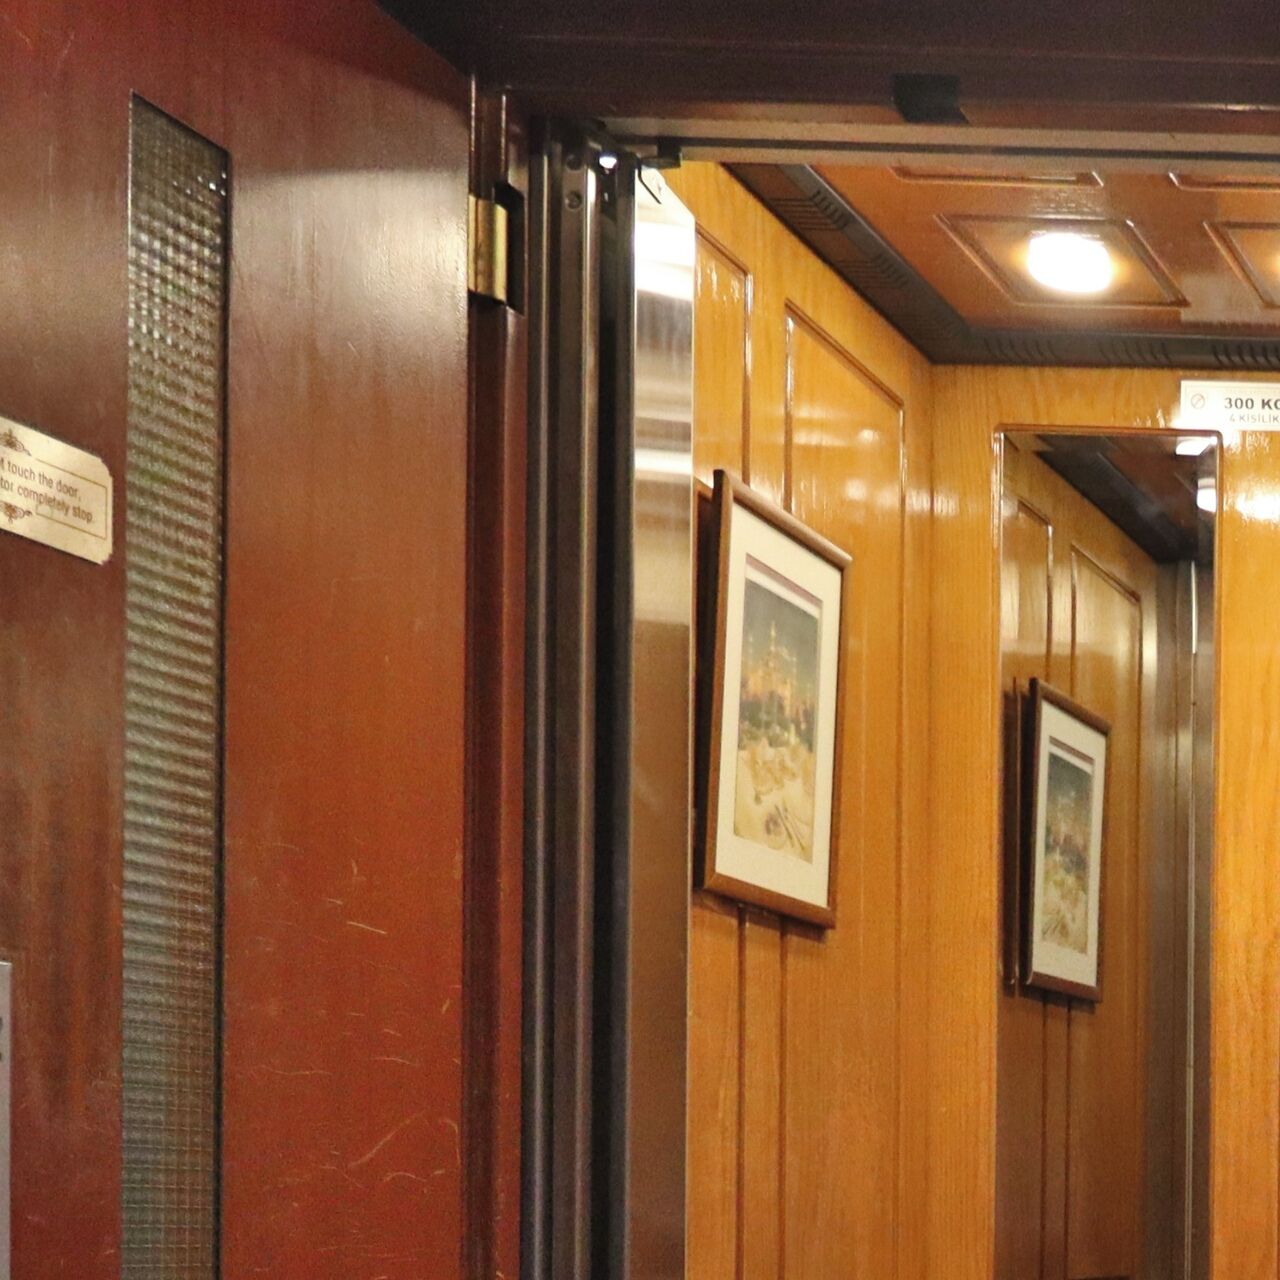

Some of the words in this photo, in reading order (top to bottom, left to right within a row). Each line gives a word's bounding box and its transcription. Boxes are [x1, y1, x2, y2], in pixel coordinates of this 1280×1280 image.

[1223, 397, 1255, 411] 300
[7, 460, 36, 480] touch
[38, 471, 54, 489] the
[17, 485, 70, 517] completely
